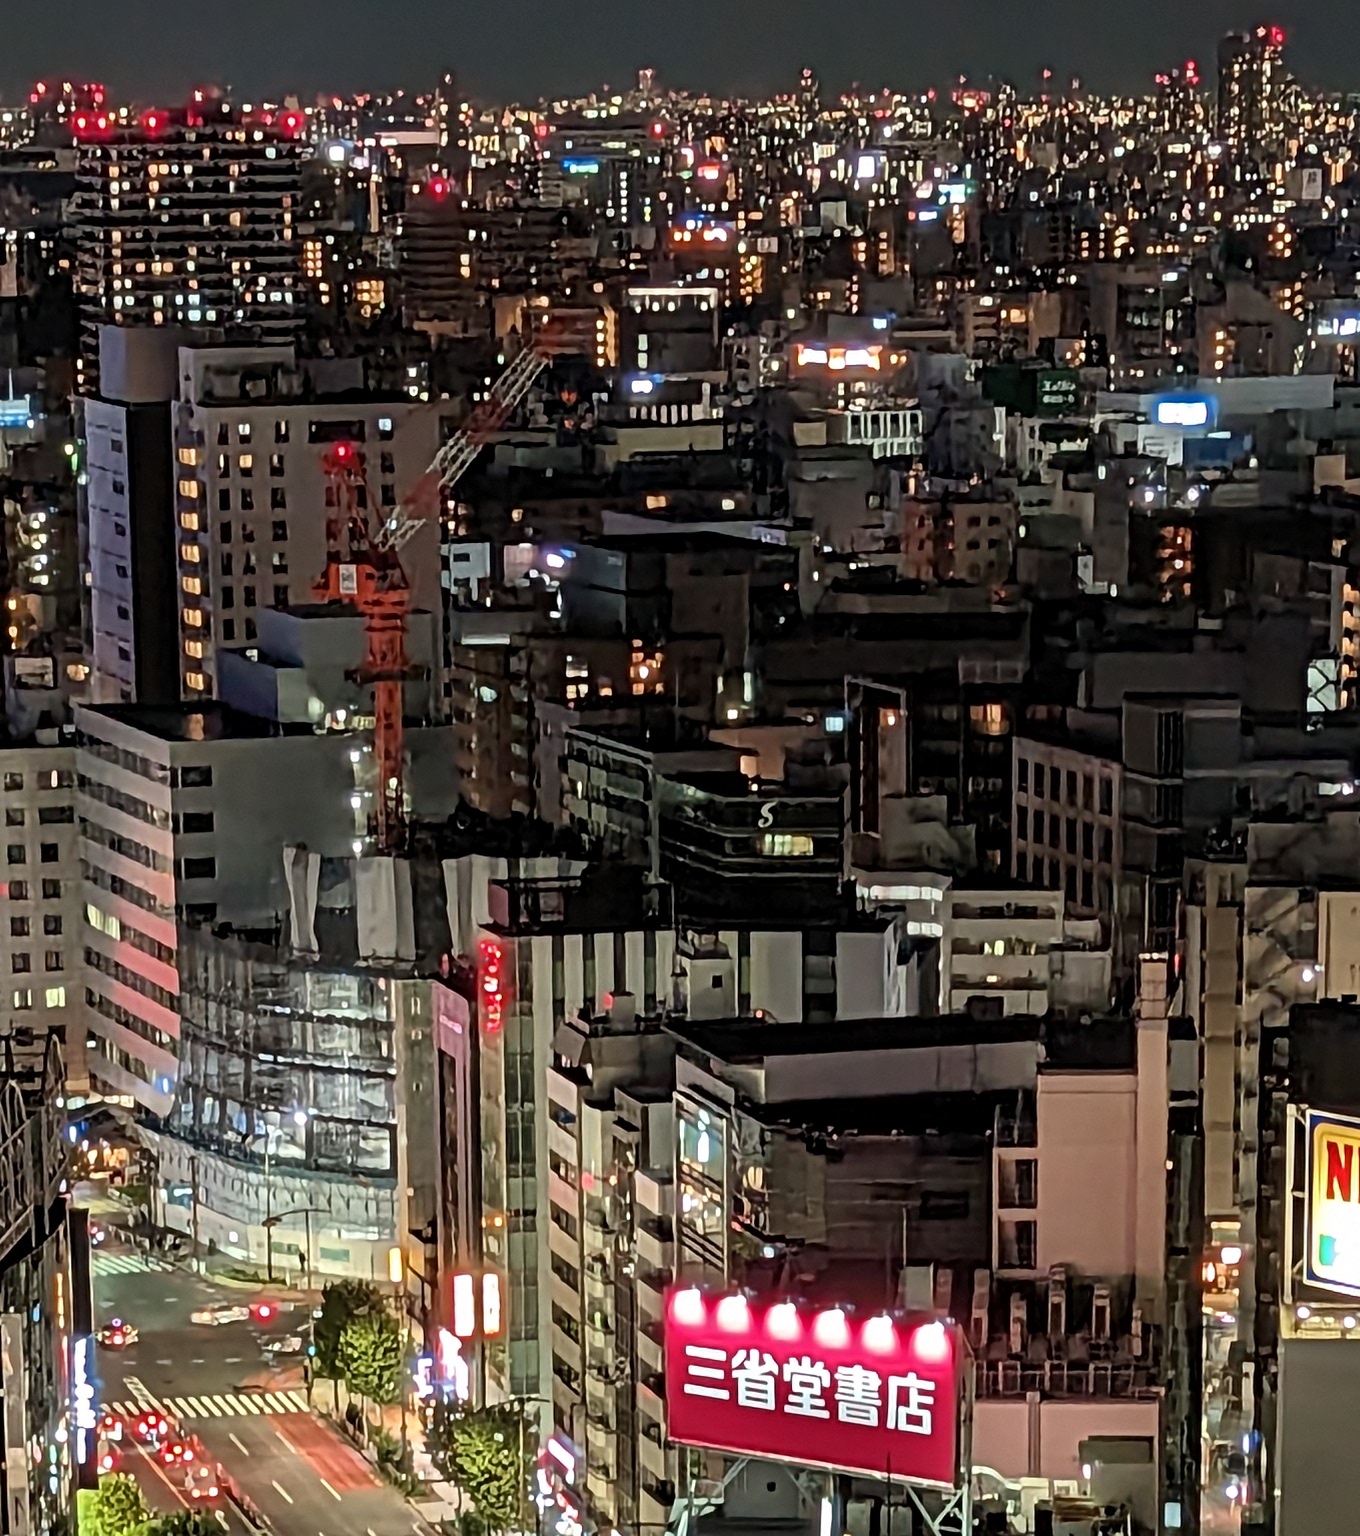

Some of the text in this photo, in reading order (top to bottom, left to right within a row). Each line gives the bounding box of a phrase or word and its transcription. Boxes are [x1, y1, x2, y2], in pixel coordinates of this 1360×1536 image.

[683, 1344, 936, 1436] 三省堂書店
